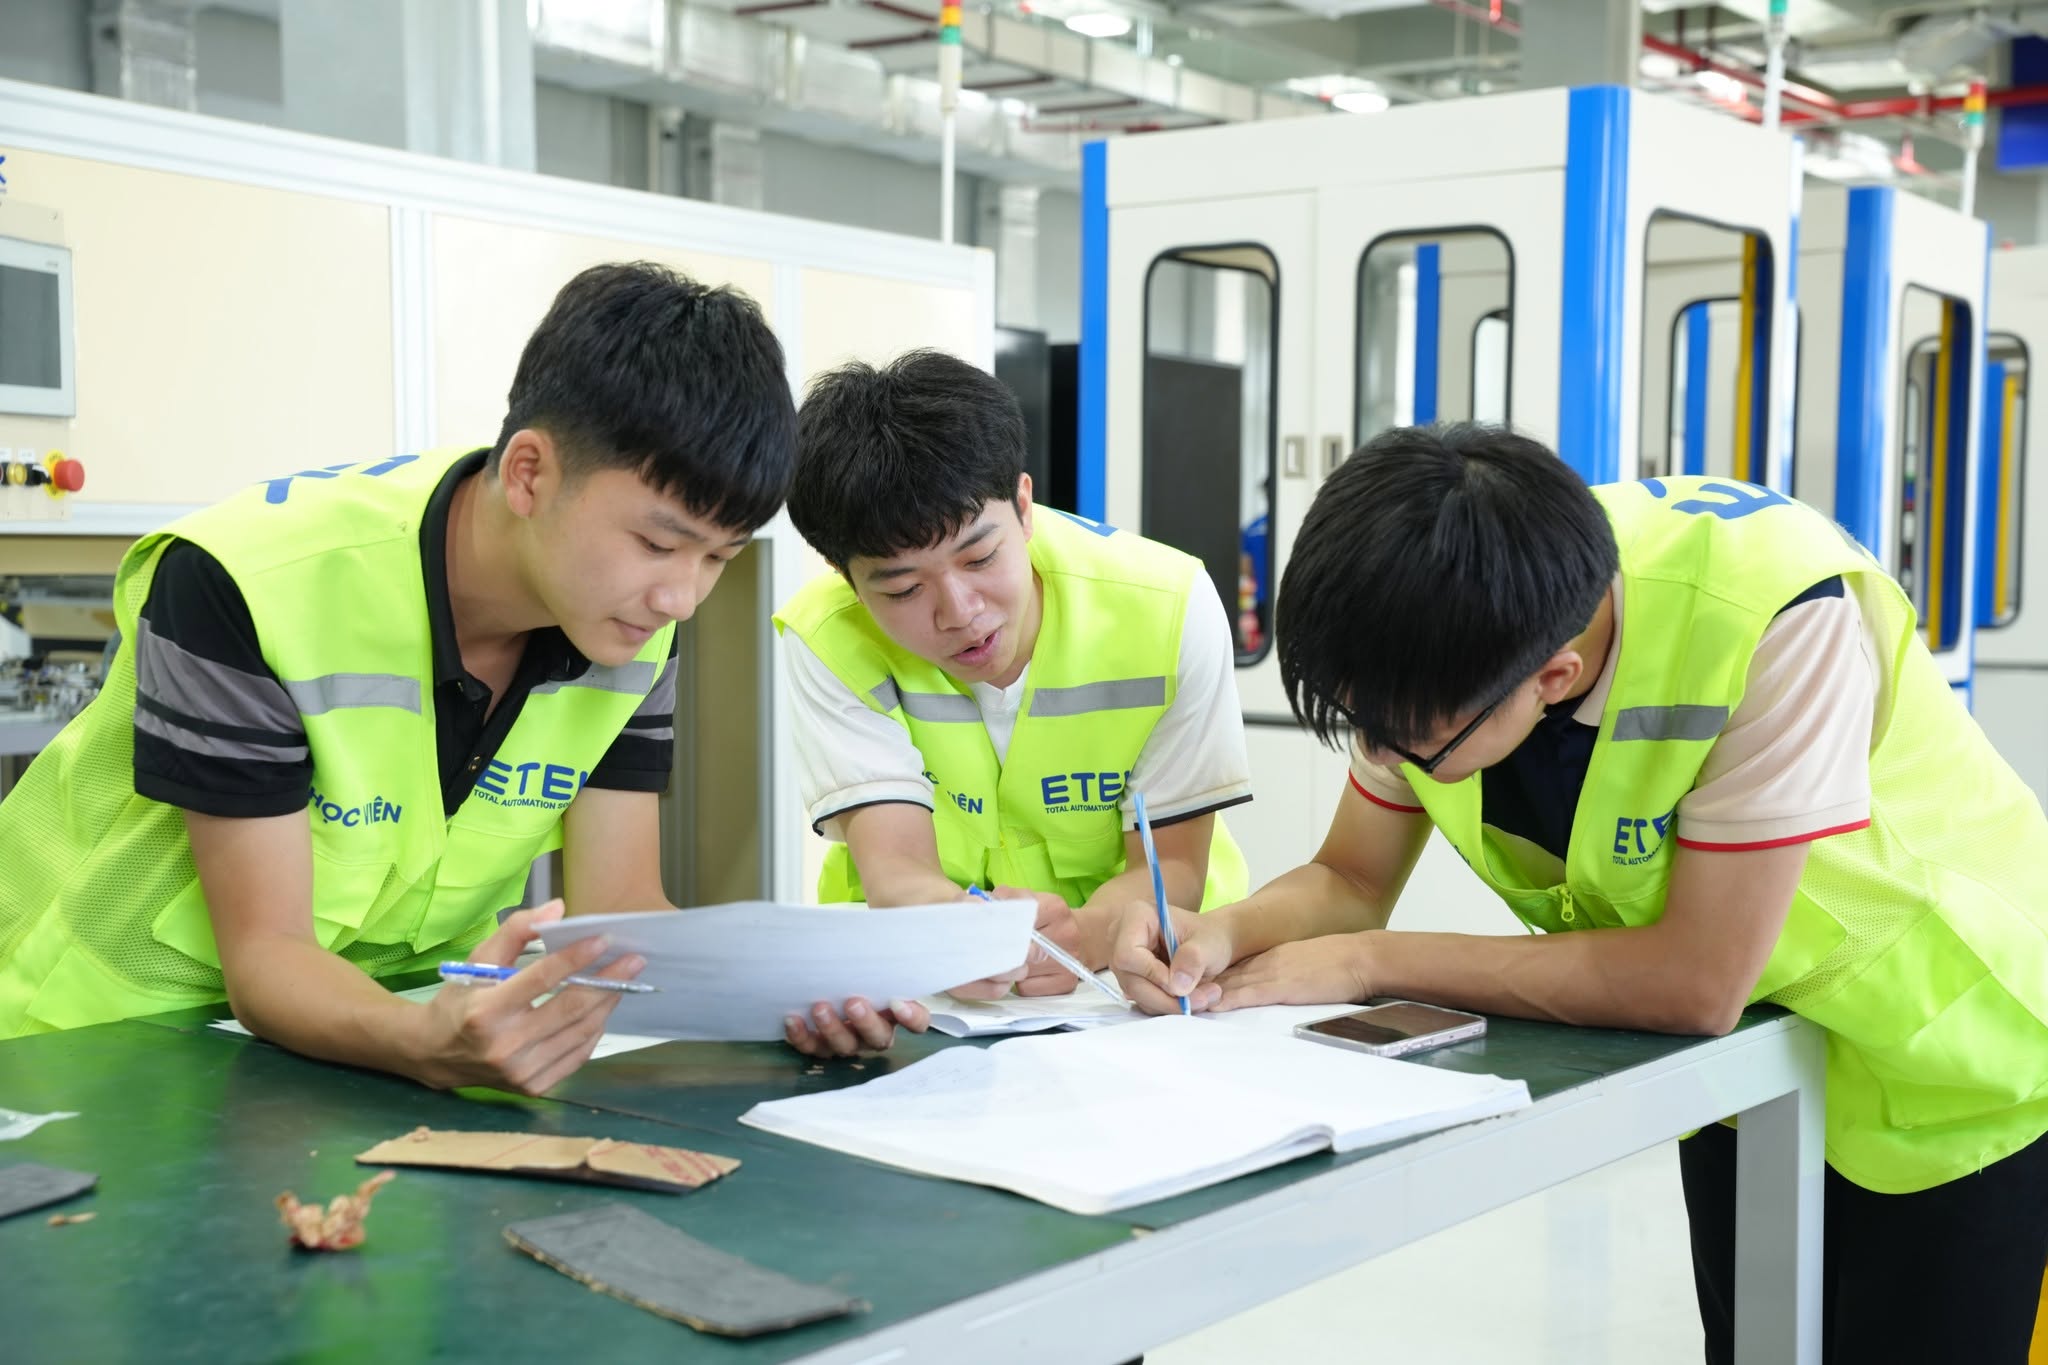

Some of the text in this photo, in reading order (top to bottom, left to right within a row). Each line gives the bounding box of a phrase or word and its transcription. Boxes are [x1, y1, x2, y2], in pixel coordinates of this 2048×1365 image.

[363, 795, 402, 826] VIÊN
[474, 789, 499, 805] TOTAL
[501, 798, 556, 810] AUTOMATION
[946, 790, 983, 815] IÊN
[1045, 806, 1068, 814] TOTAL
